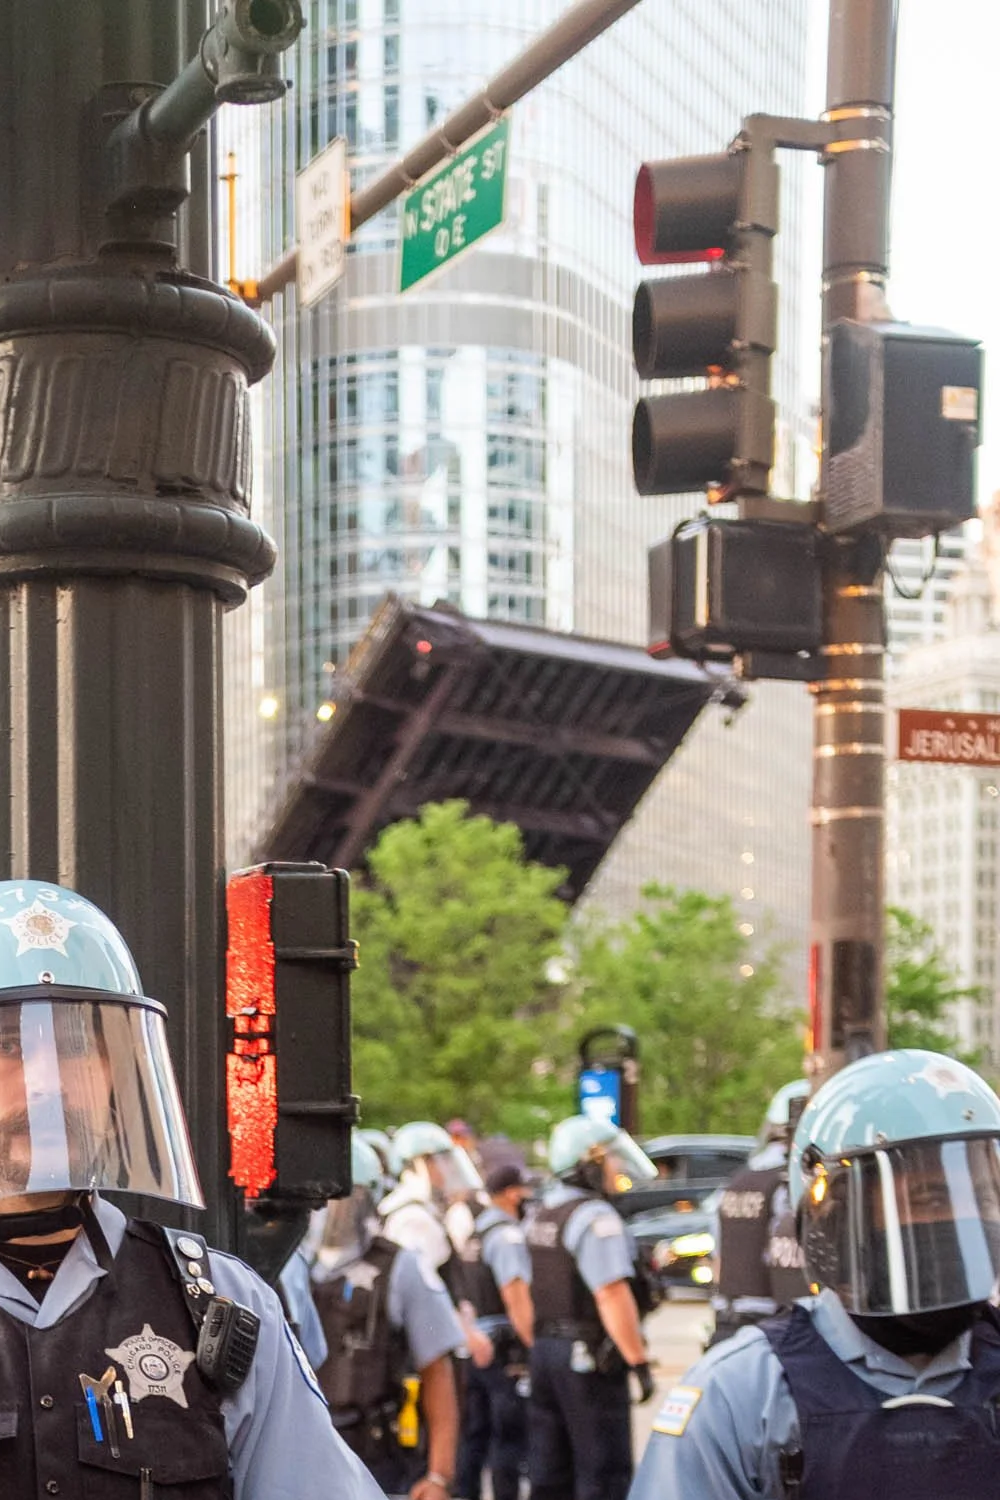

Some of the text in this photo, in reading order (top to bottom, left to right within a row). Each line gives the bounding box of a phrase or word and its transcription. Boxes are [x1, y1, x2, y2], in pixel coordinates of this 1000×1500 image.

[420, 154, 478, 232] STATE
[481, 140, 505, 180] ST
[23, 931, 63, 946] POLICE
[127, 1343, 181, 1375] CHICAGO POLICE
